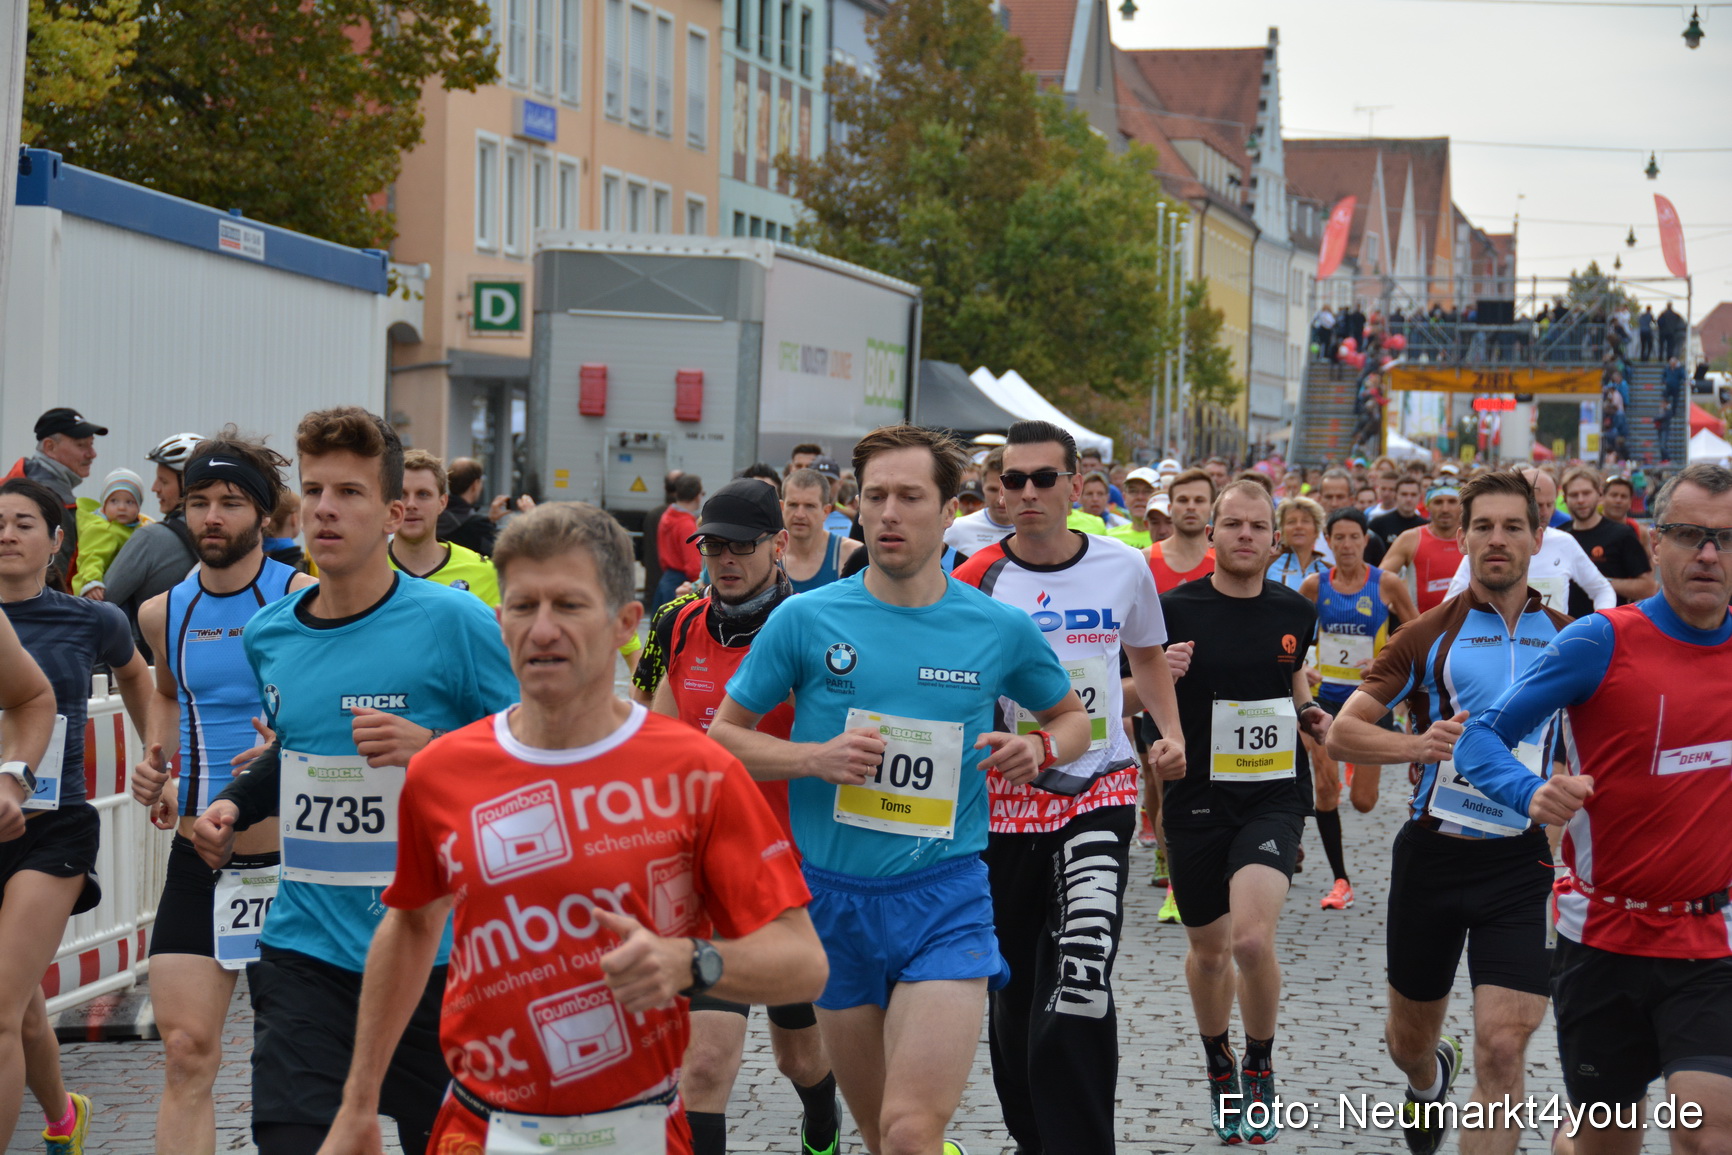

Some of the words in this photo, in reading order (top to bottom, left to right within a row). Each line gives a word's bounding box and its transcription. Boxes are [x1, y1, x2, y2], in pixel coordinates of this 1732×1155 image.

[481, 288, 516, 325] D
[1339, 649, 1349, 665] 2
[826, 678, 856, 690] PARTL
[919, 667, 979, 686] BOCK
[340, 694, 408, 711] BOCK
[890, 727, 933, 742] BOCK
[1234, 724, 1278, 750] 136
[1236, 758, 1274, 768] Christian
[1679, 751, 1713, 766] DEHN
[318, 767, 364, 779] BOCK
[295, 793, 386, 835] 2735
[478, 788, 552, 826] raumbox
[881, 797, 912, 815] Toms
[1462, 798, 1504, 818] Andreas
[584, 825, 679, 857] schenken
[1625, 898, 1648, 910] Stiegl
[482, 962, 557, 1000] wohnen
[535, 987, 612, 1024] raumbox
[557, 1127, 617, 1147] BOCK
